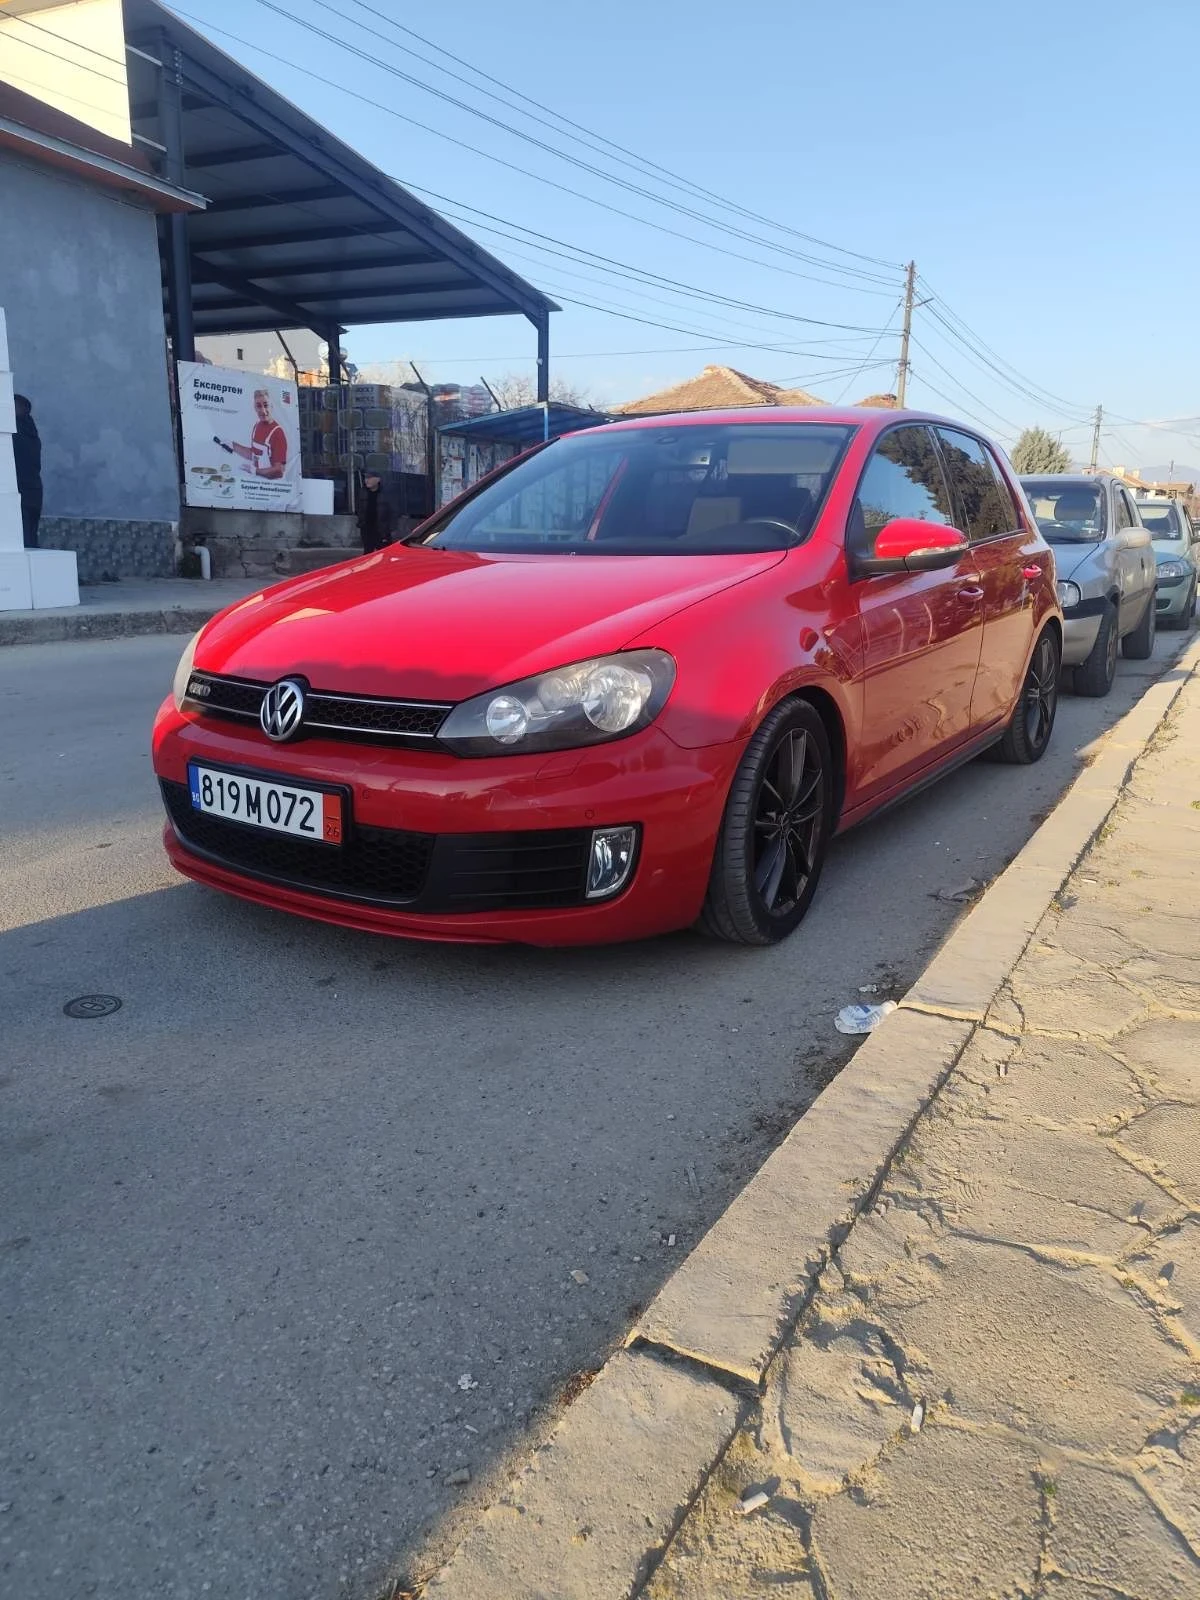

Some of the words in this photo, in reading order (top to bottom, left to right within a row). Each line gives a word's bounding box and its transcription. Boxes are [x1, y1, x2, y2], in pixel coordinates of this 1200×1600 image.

[193, 378, 243, 395] Експертен
[194, 390, 225, 404] финал
[260, 681, 303, 742] VW
